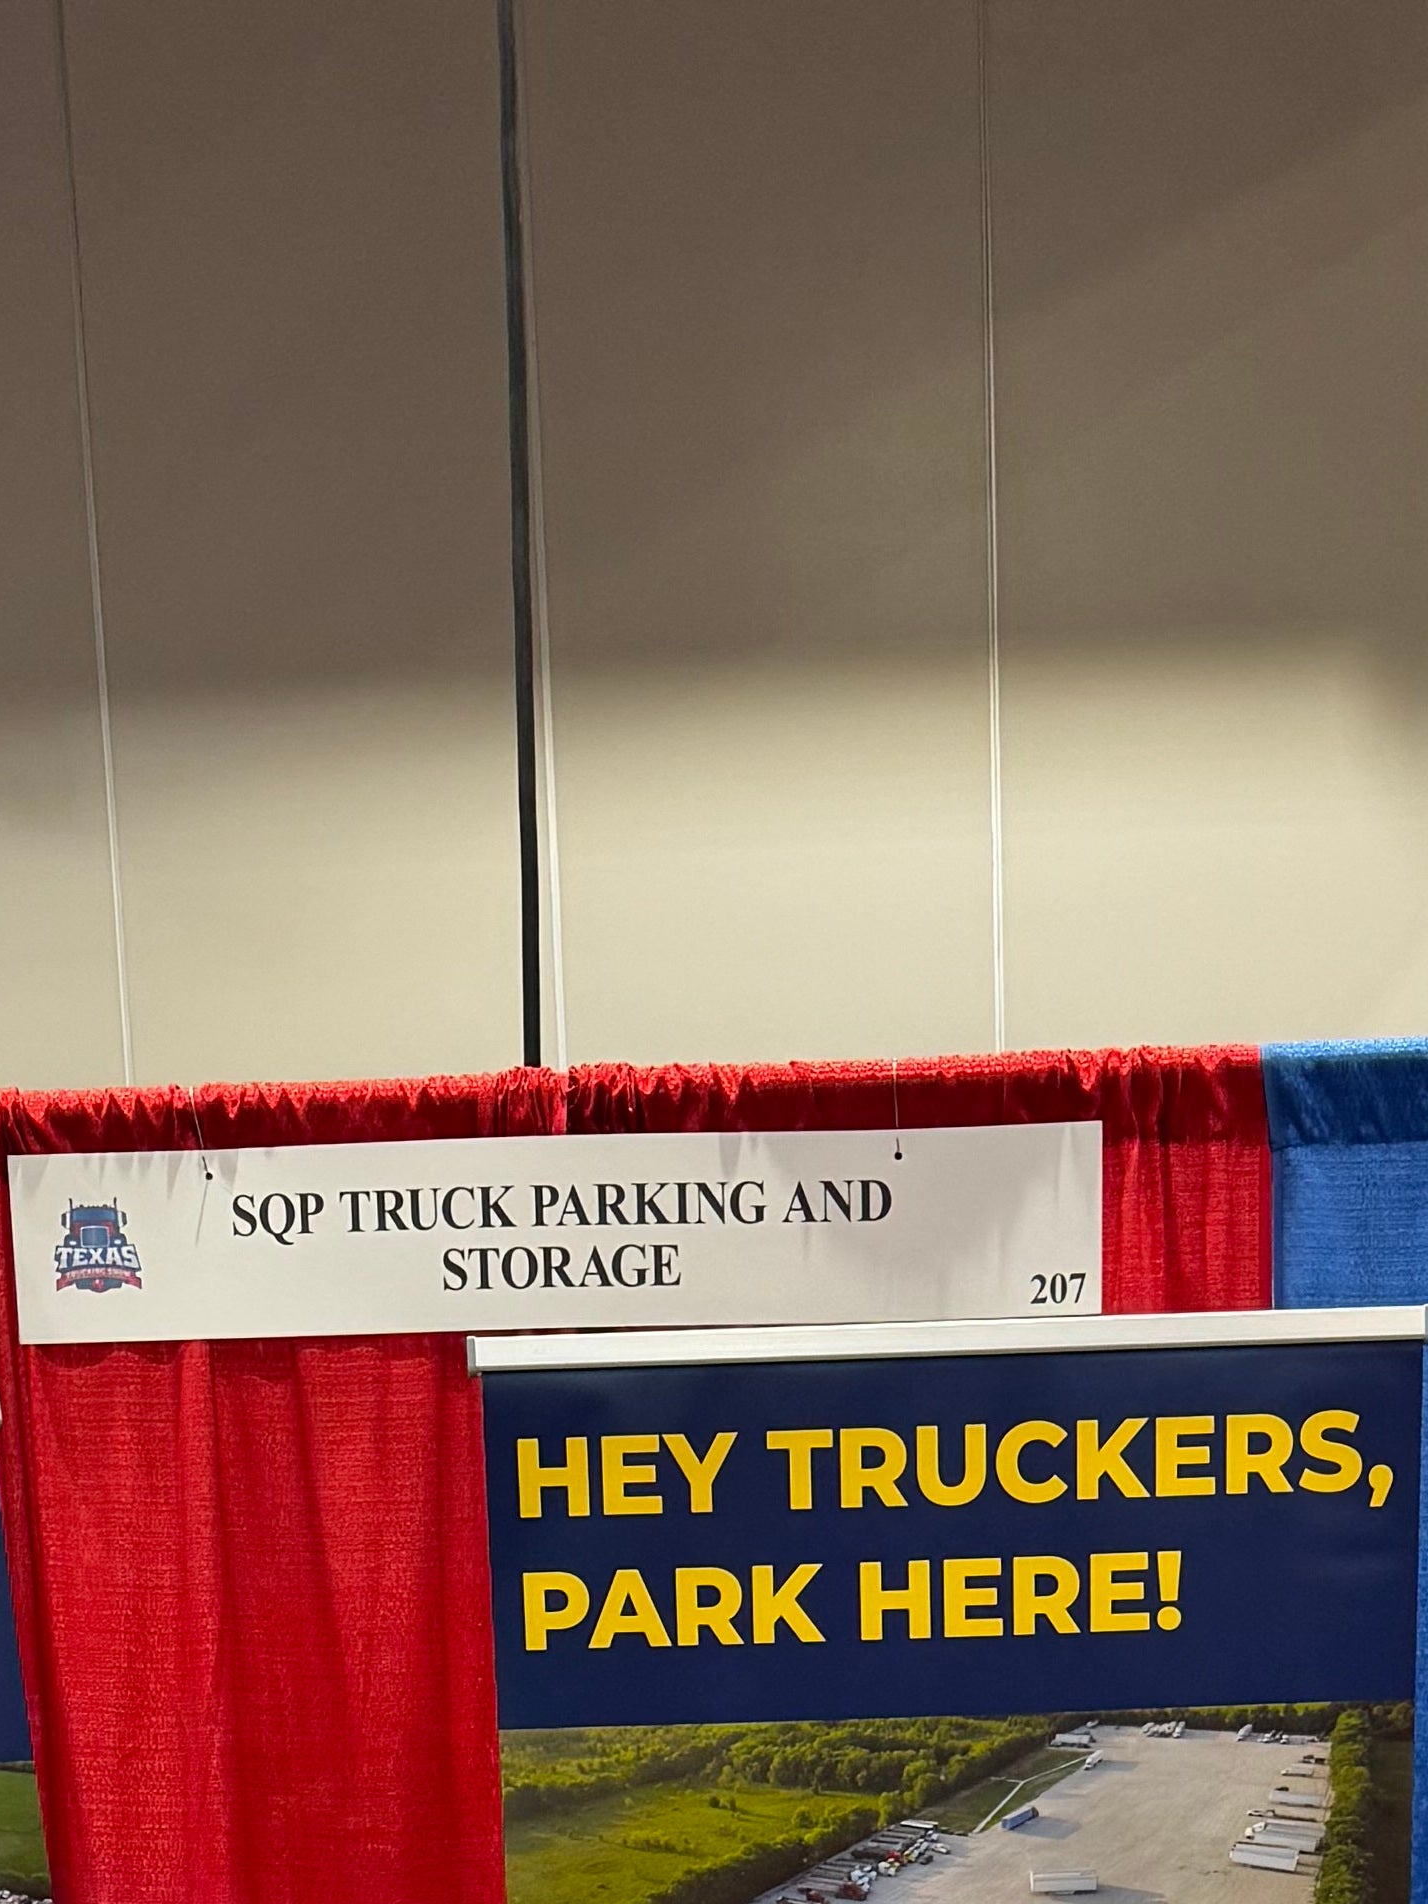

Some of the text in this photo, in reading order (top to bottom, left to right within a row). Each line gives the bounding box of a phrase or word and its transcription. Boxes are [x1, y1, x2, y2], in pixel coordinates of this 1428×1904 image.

[233, 1180, 891, 1245] SQP TRUCK PARKING AND
[56, 1246, 141, 1270] TEXAS
[444, 1245, 680, 1290] STORAGE
[1031, 1273, 1085, 1304] 207
[518, 1410, 1391, 1518] HEY TRUCKERS,
[523, 1552, 1180, 1650] PARK HERE!
